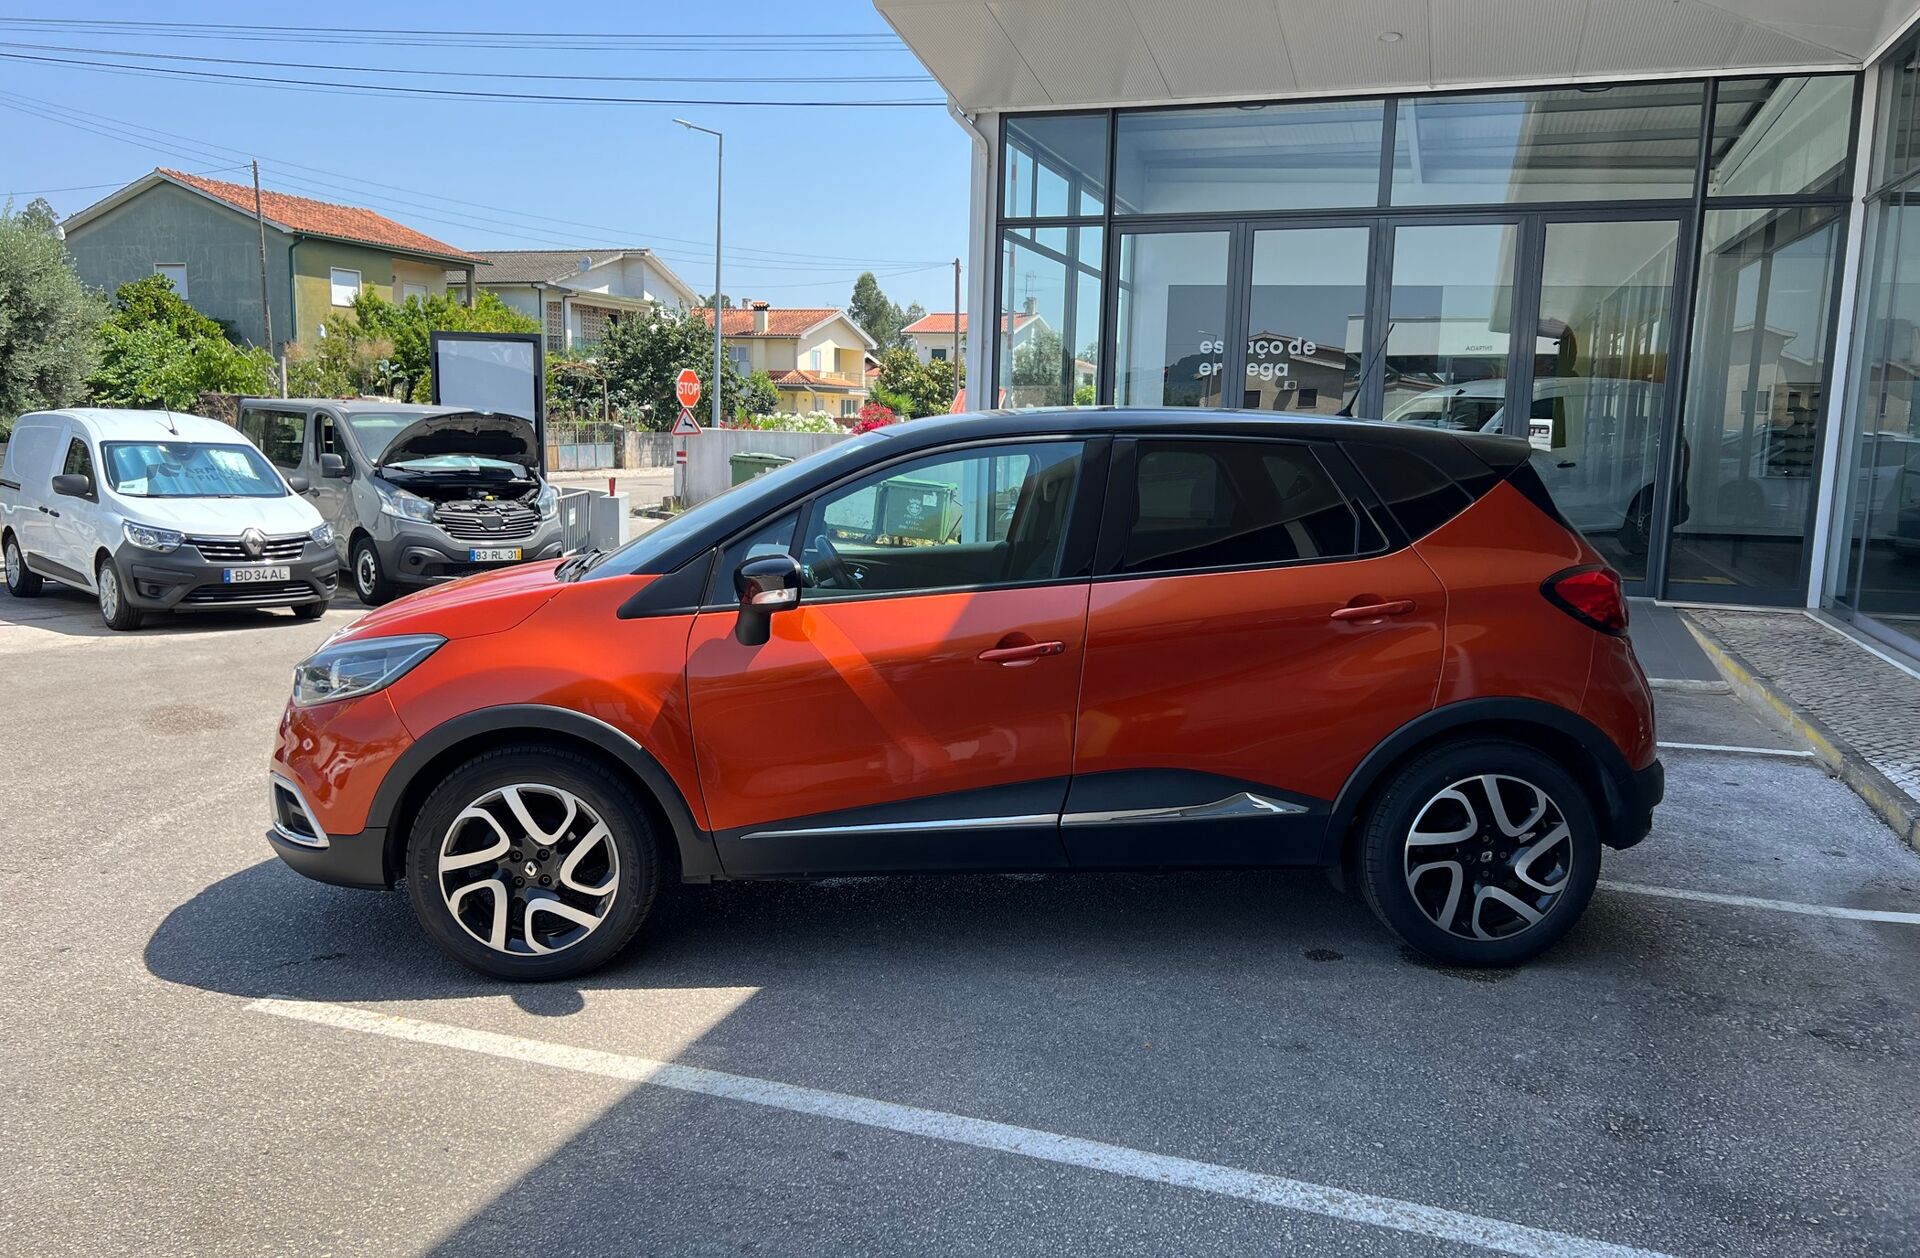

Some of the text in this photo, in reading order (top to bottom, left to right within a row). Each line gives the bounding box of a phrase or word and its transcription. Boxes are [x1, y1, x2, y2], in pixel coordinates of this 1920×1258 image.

[1200, 337, 1316, 359] esço de
[1199, 362, 1288, 380] enega
[679, 382, 700, 395] STOP
[476, 551, 487, 560] 83
[491, 551, 503, 559] RL
[508, 551, 516, 559] 31
[235, 570, 284, 581] BD 34 AL
